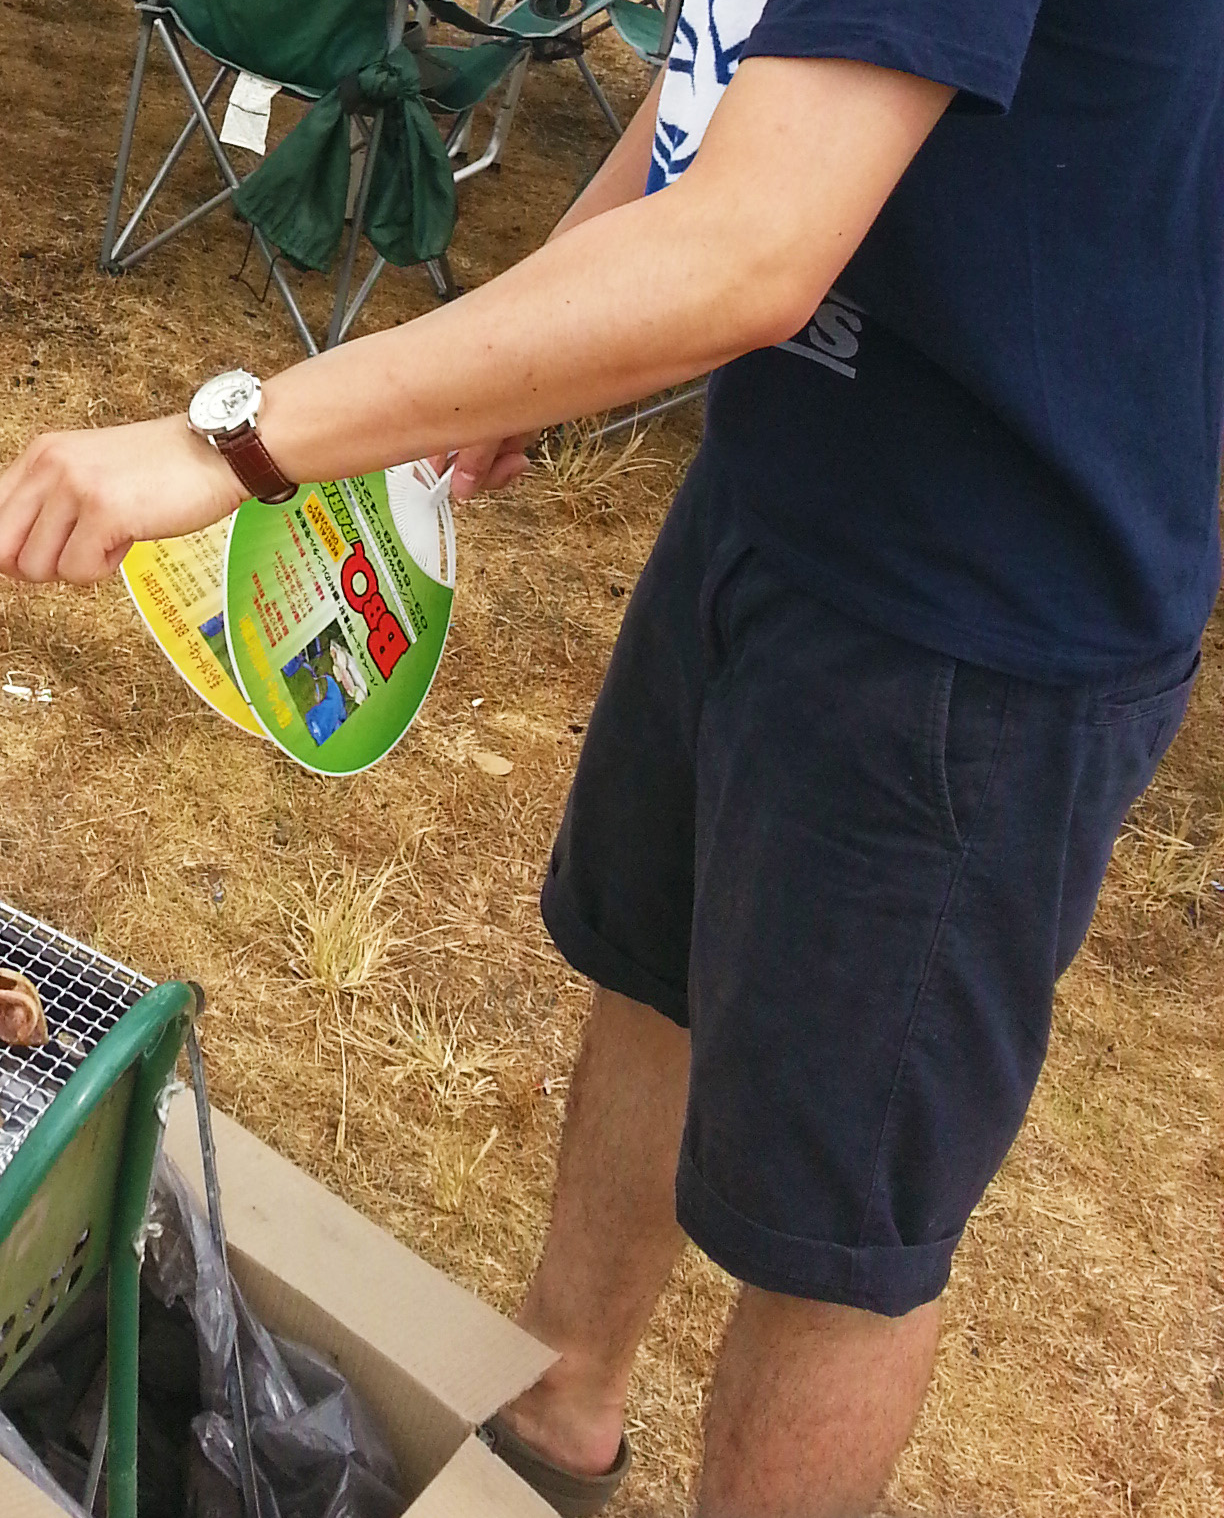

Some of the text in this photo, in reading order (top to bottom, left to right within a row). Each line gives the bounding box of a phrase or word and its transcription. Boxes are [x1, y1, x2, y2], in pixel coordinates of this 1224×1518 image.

[313, 504, 339, 545] DELIVERY
[319, 478, 359, 542] PARK
[341, 542, 410, 682] BBQ
